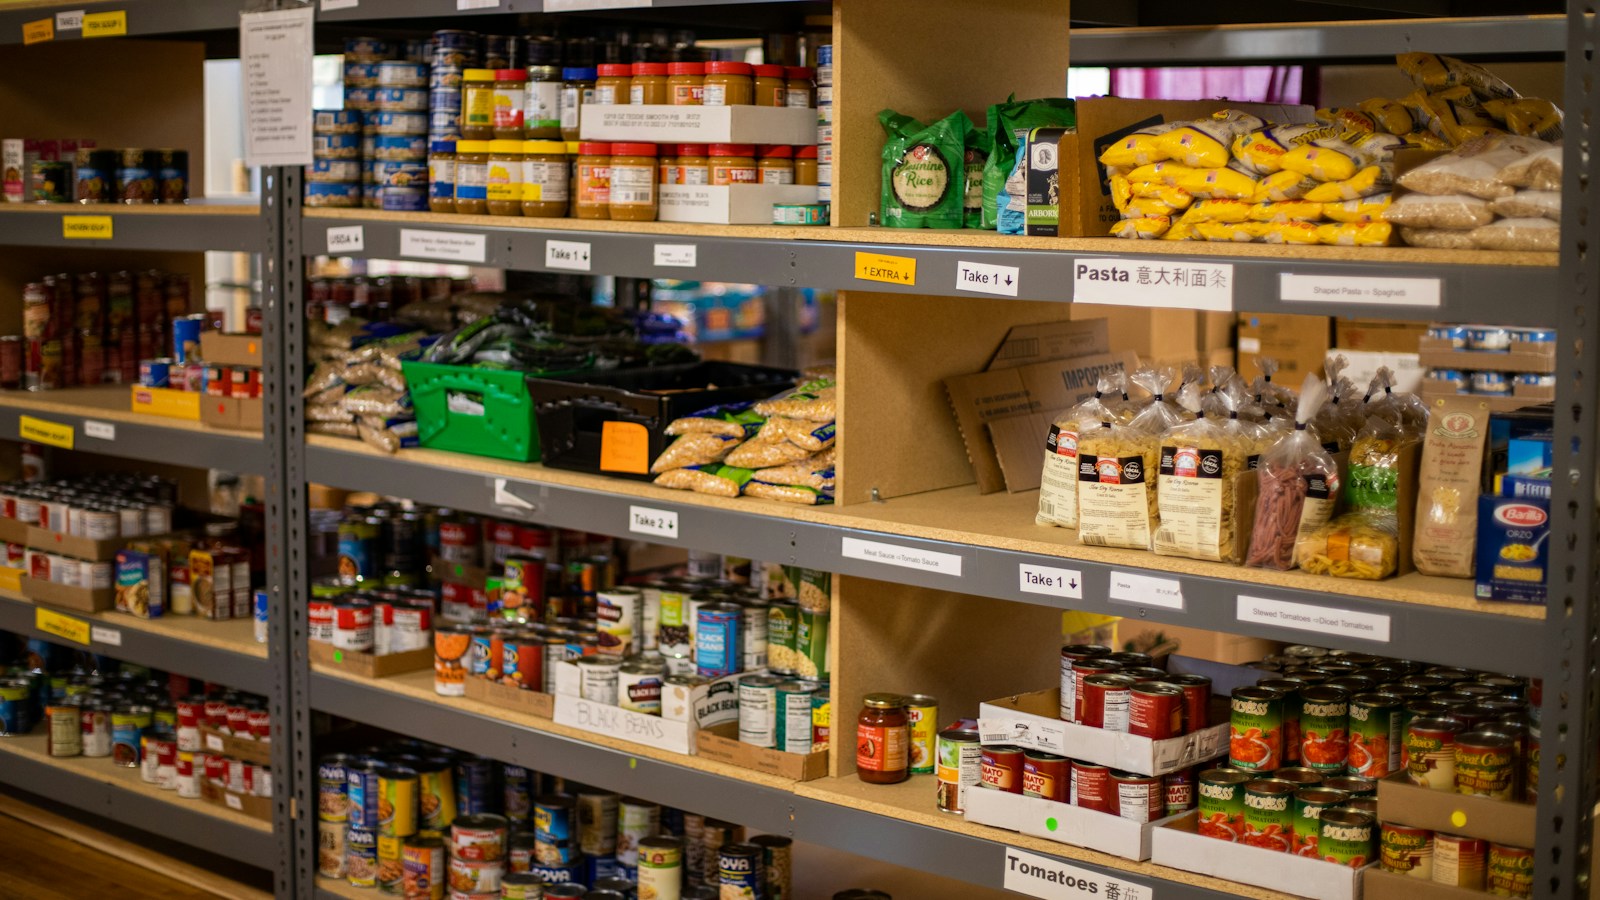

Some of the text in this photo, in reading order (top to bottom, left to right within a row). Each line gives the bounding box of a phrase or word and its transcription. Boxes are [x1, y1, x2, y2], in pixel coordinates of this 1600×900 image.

[906, 171, 933, 188] Rice
[550, 248, 578, 260] Take 1
[870, 268, 900, 280] EXTRA
[962, 268, 998, 284] Take 1
[1076, 264, 1226, 288] Pasta 意大利面条
[1314, 286, 1406, 297] Shaped Pasta Spaghetti
[634, 513, 663, 528] Take 2
[1506, 509, 1542, 521] Barilla
[1507, 530, 1533, 539] ORZO
[878, 551, 896, 560] Sauce
[902, 554, 920, 564] Tomato
[922, 558, 939, 567] Sauce
[1024, 571, 1062, 588] Take 1
[1252, 607, 1374, 631] Stewed Tomatoes Diced Tomatoes
[698, 701, 719, 719] BLACK
[576, 702, 664, 739] BLACK BEANS
[982, 765, 1003, 777] MATO
[982, 773, 999, 784] AUCE
[1024, 773, 1045, 785] MATO
[1024, 781, 1041, 792] AUCE
[1008, 855, 1098, 894] Tomatoes
